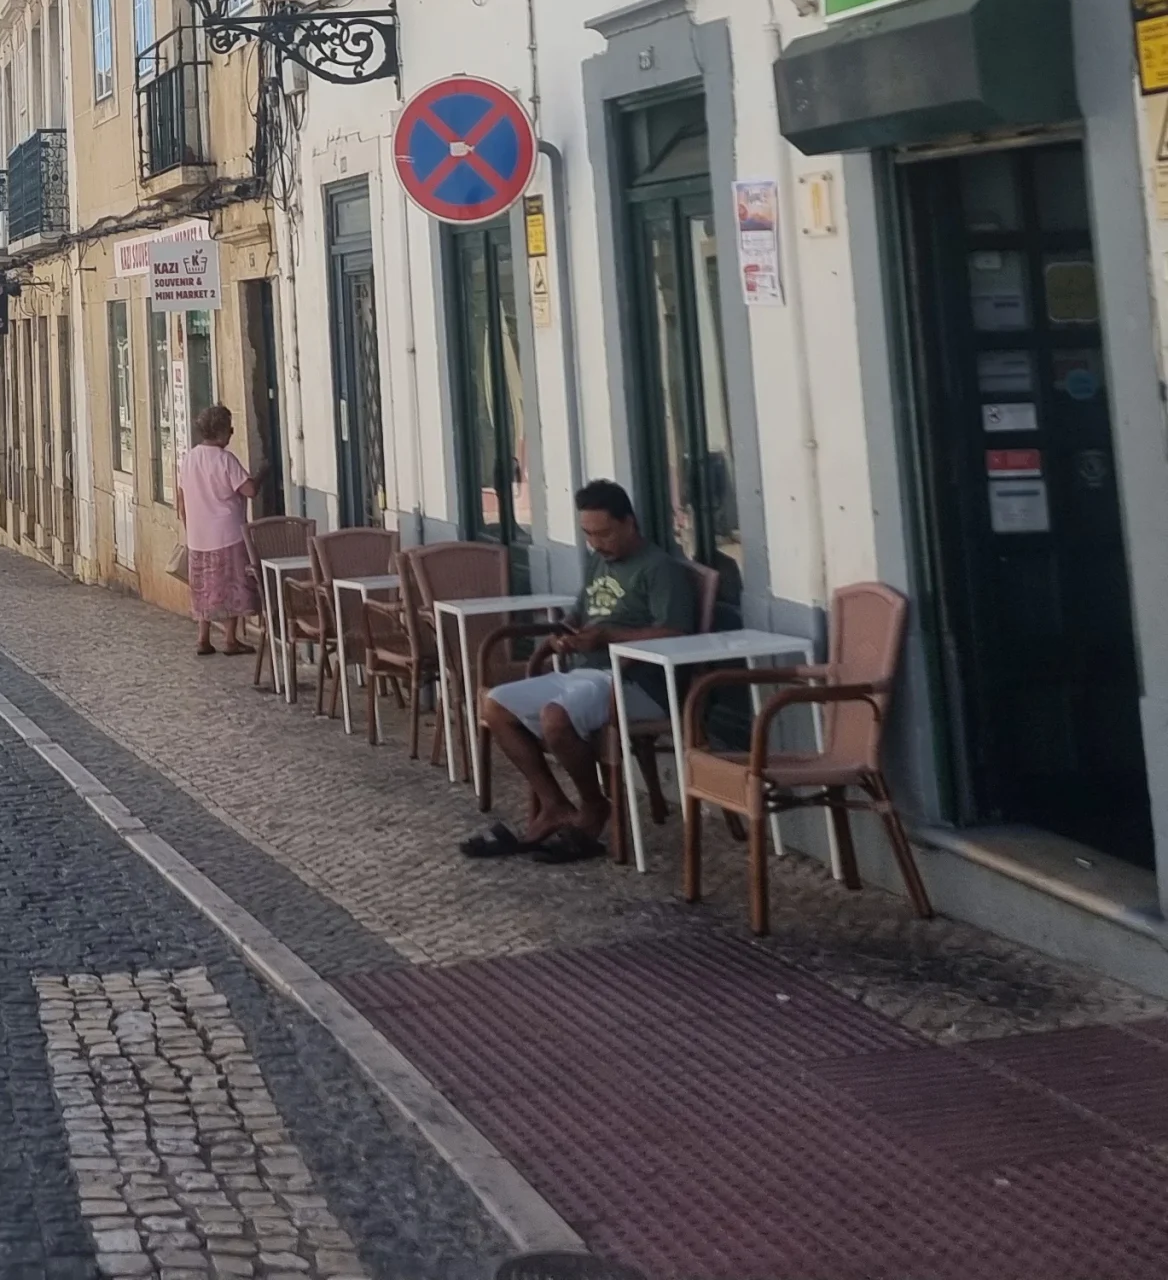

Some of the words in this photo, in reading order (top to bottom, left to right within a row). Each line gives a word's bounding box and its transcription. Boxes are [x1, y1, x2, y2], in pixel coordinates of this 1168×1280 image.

[192, 255, 199, 266] K
[154, 263, 179, 274] KAZI
[154, 278, 194, 287] SOUVENIR
[196, 277, 202, 286] &
[155, 291, 174, 300] MINI
[175, 290, 208, 300] MARKET
[210, 290, 215, 298] 2
